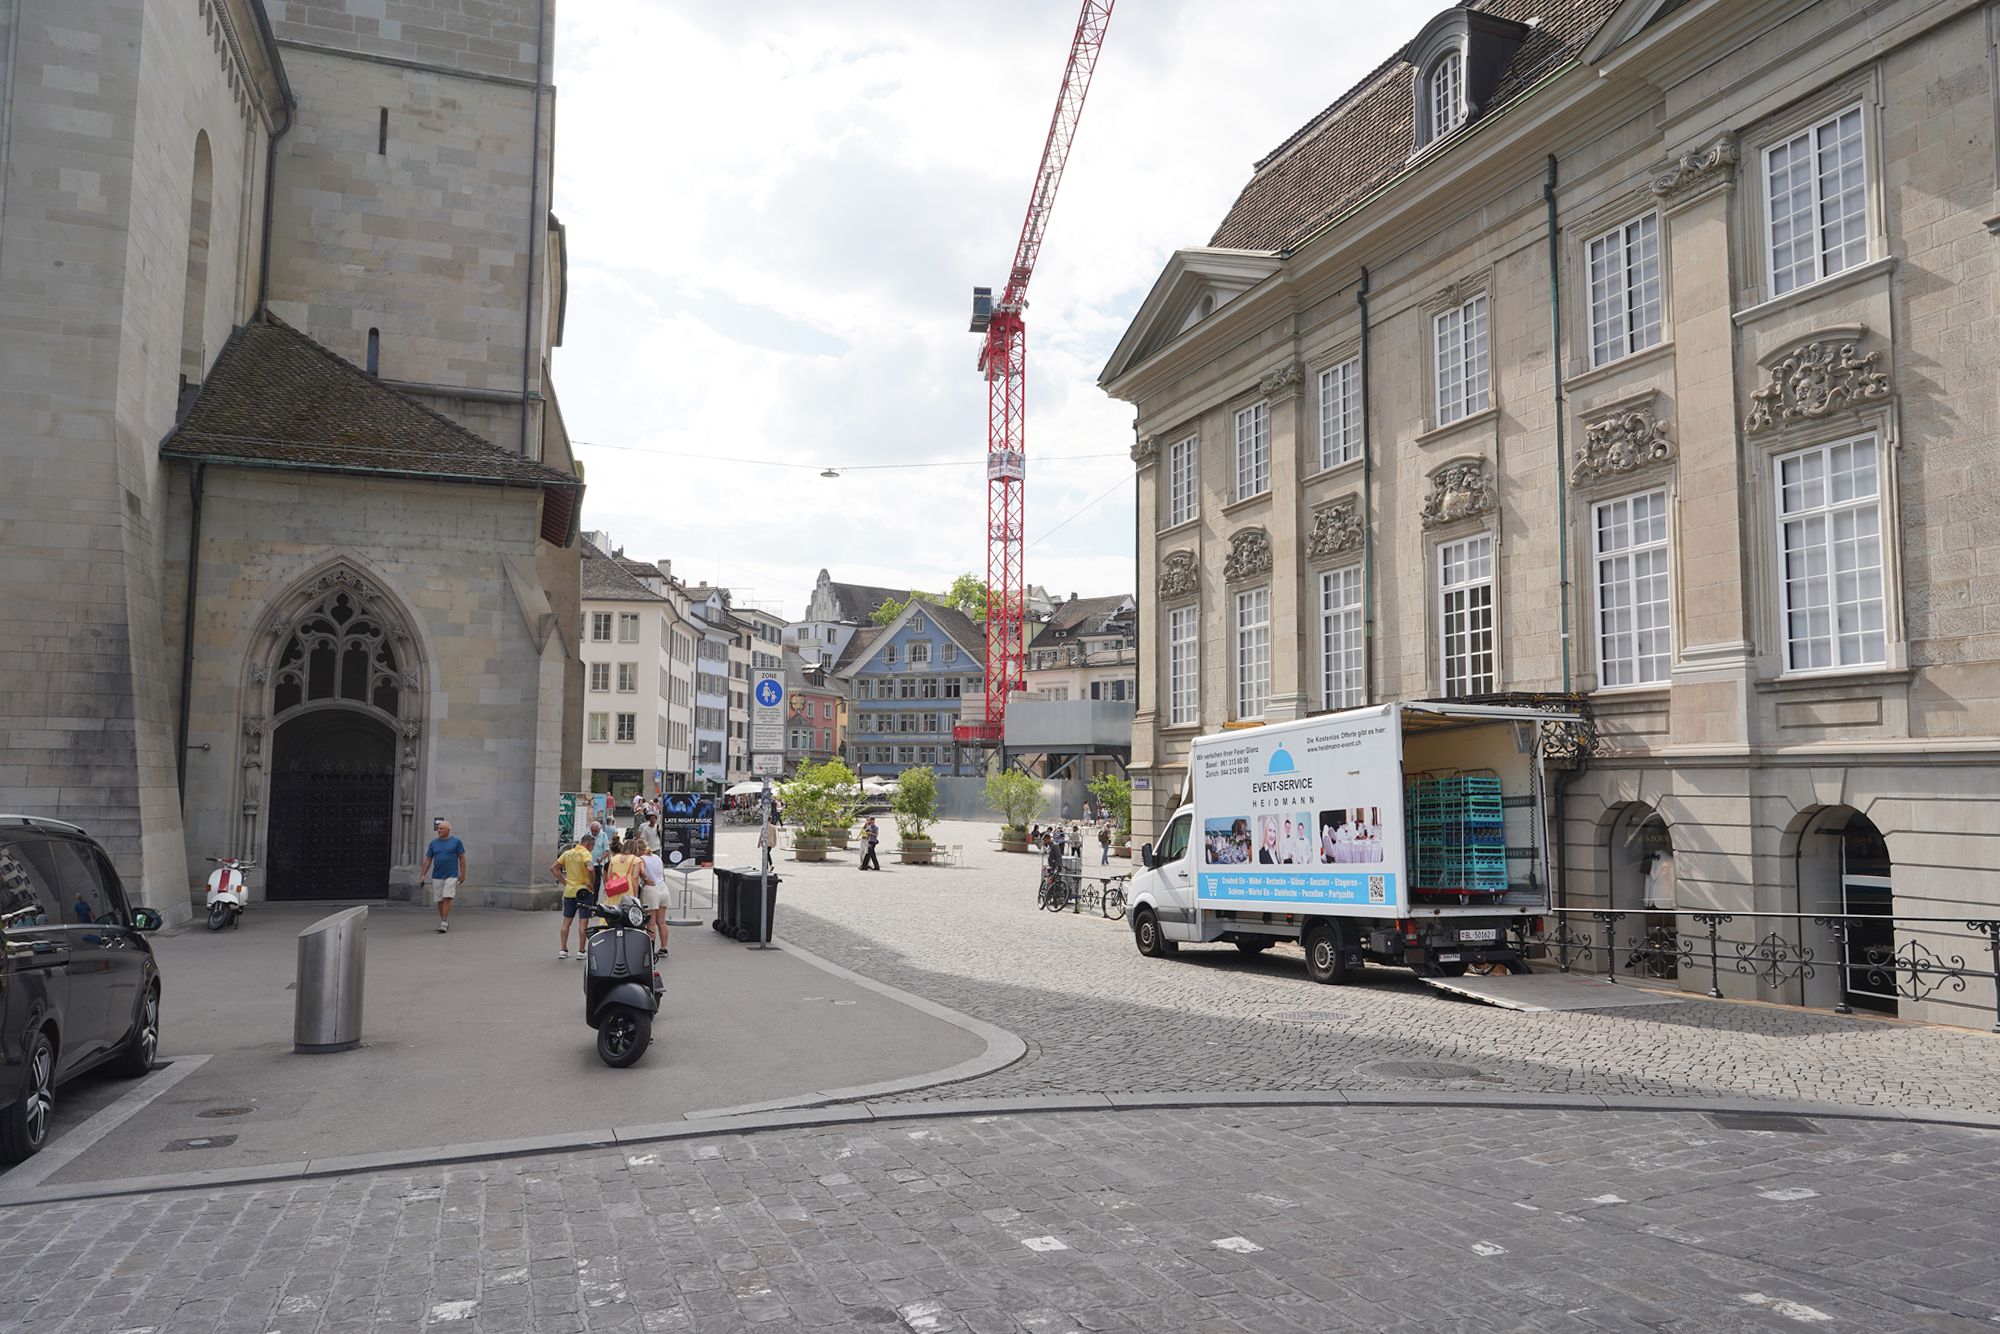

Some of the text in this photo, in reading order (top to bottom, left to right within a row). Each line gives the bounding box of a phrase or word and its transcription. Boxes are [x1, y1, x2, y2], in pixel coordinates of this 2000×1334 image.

[1315, 734, 1340, 743] Kostenlos
[1340, 730, 1357, 739] Offerte
[1357, 728, 1368, 738] gibt
[1246, 746, 1259, 754] Glanz
[1307, 740, 1362, 752] www.heidmann-event.ch
[1252, 777, 1313, 793] EVENT-SERVICE
[1252, 795, 1315, 808] HEIDMANN
[1465, 931, 1472, 940] BL
